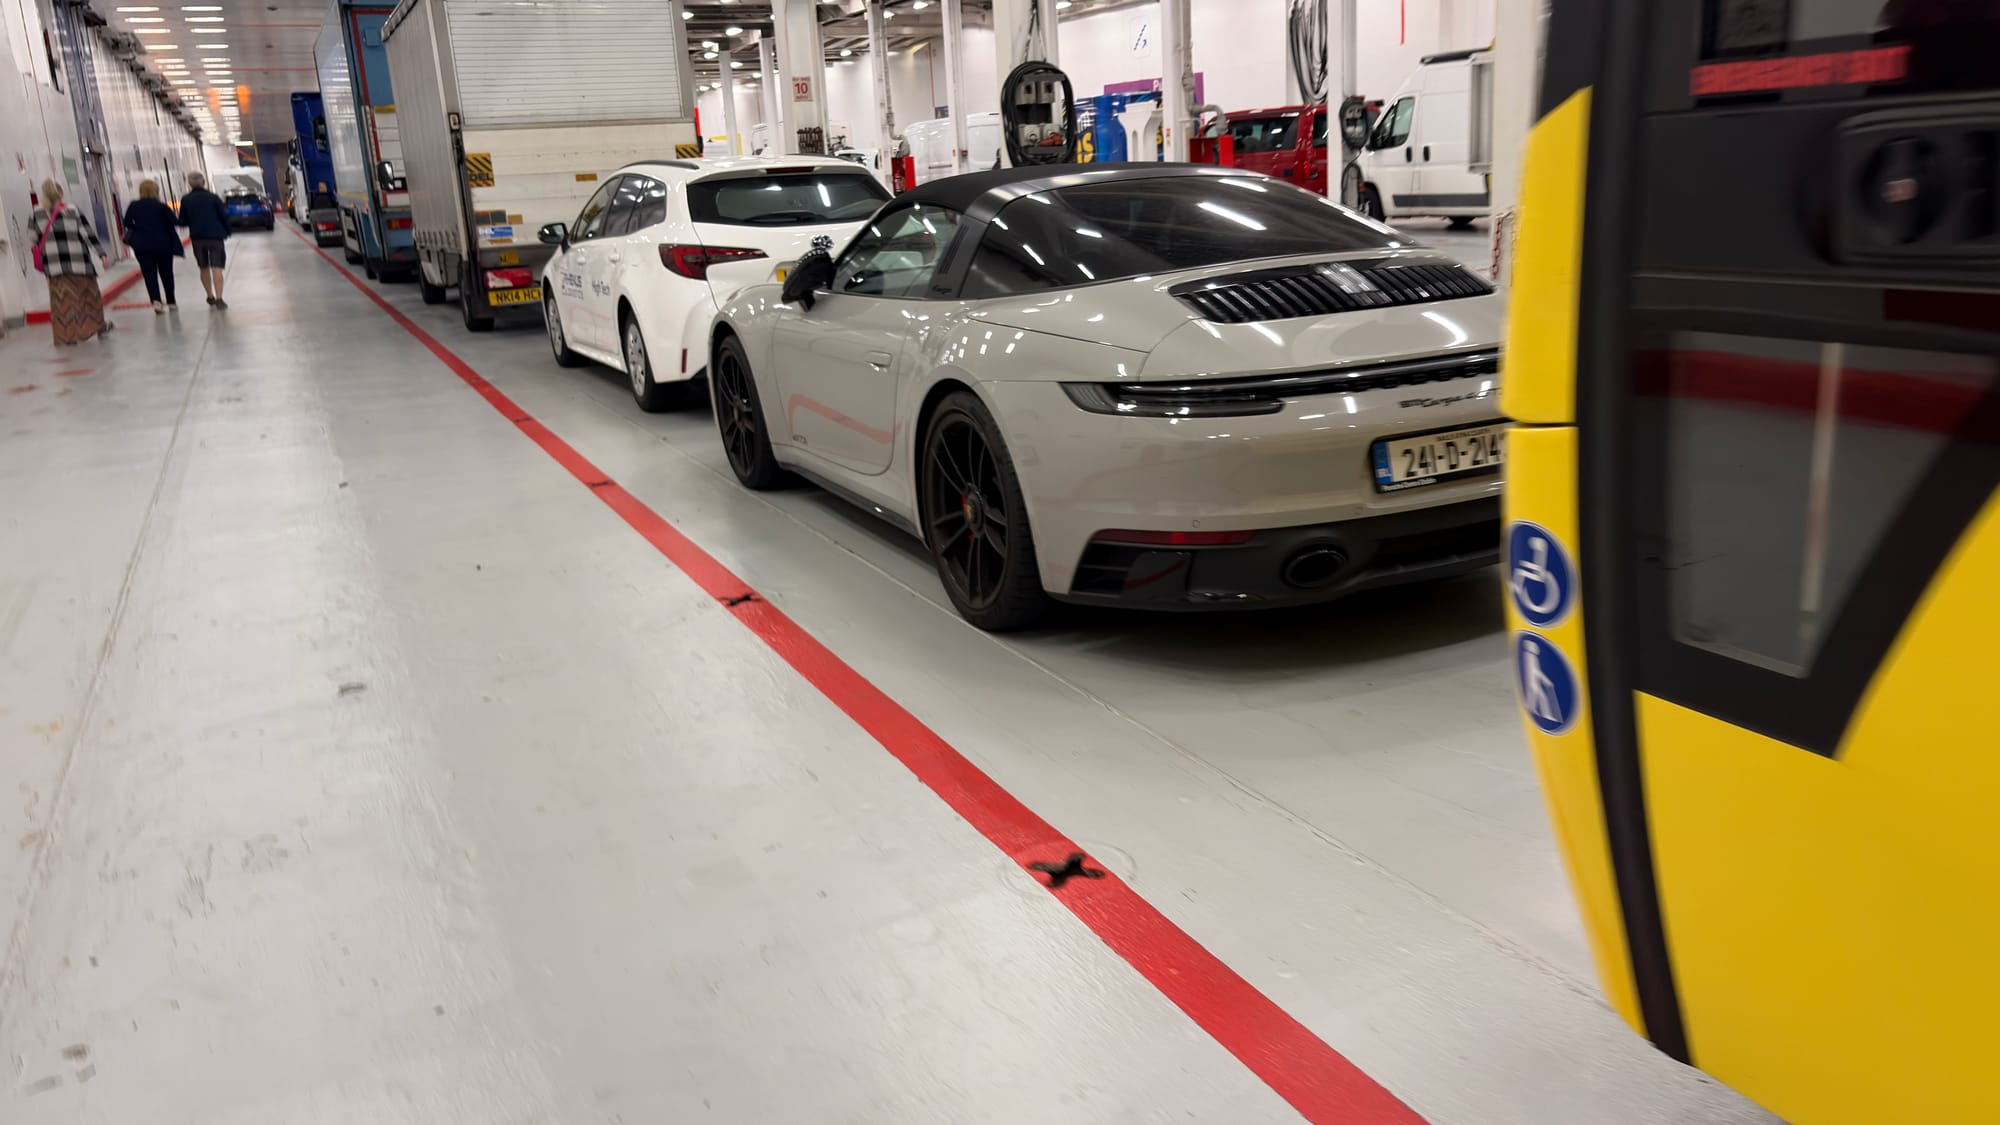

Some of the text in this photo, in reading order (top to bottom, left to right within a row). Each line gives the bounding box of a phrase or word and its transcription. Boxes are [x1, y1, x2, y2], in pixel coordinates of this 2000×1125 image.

[795, 82, 808, 94] 10
[495, 289, 520, 304] NK14
[1402, 432, 1506, 478] 241-D-214
